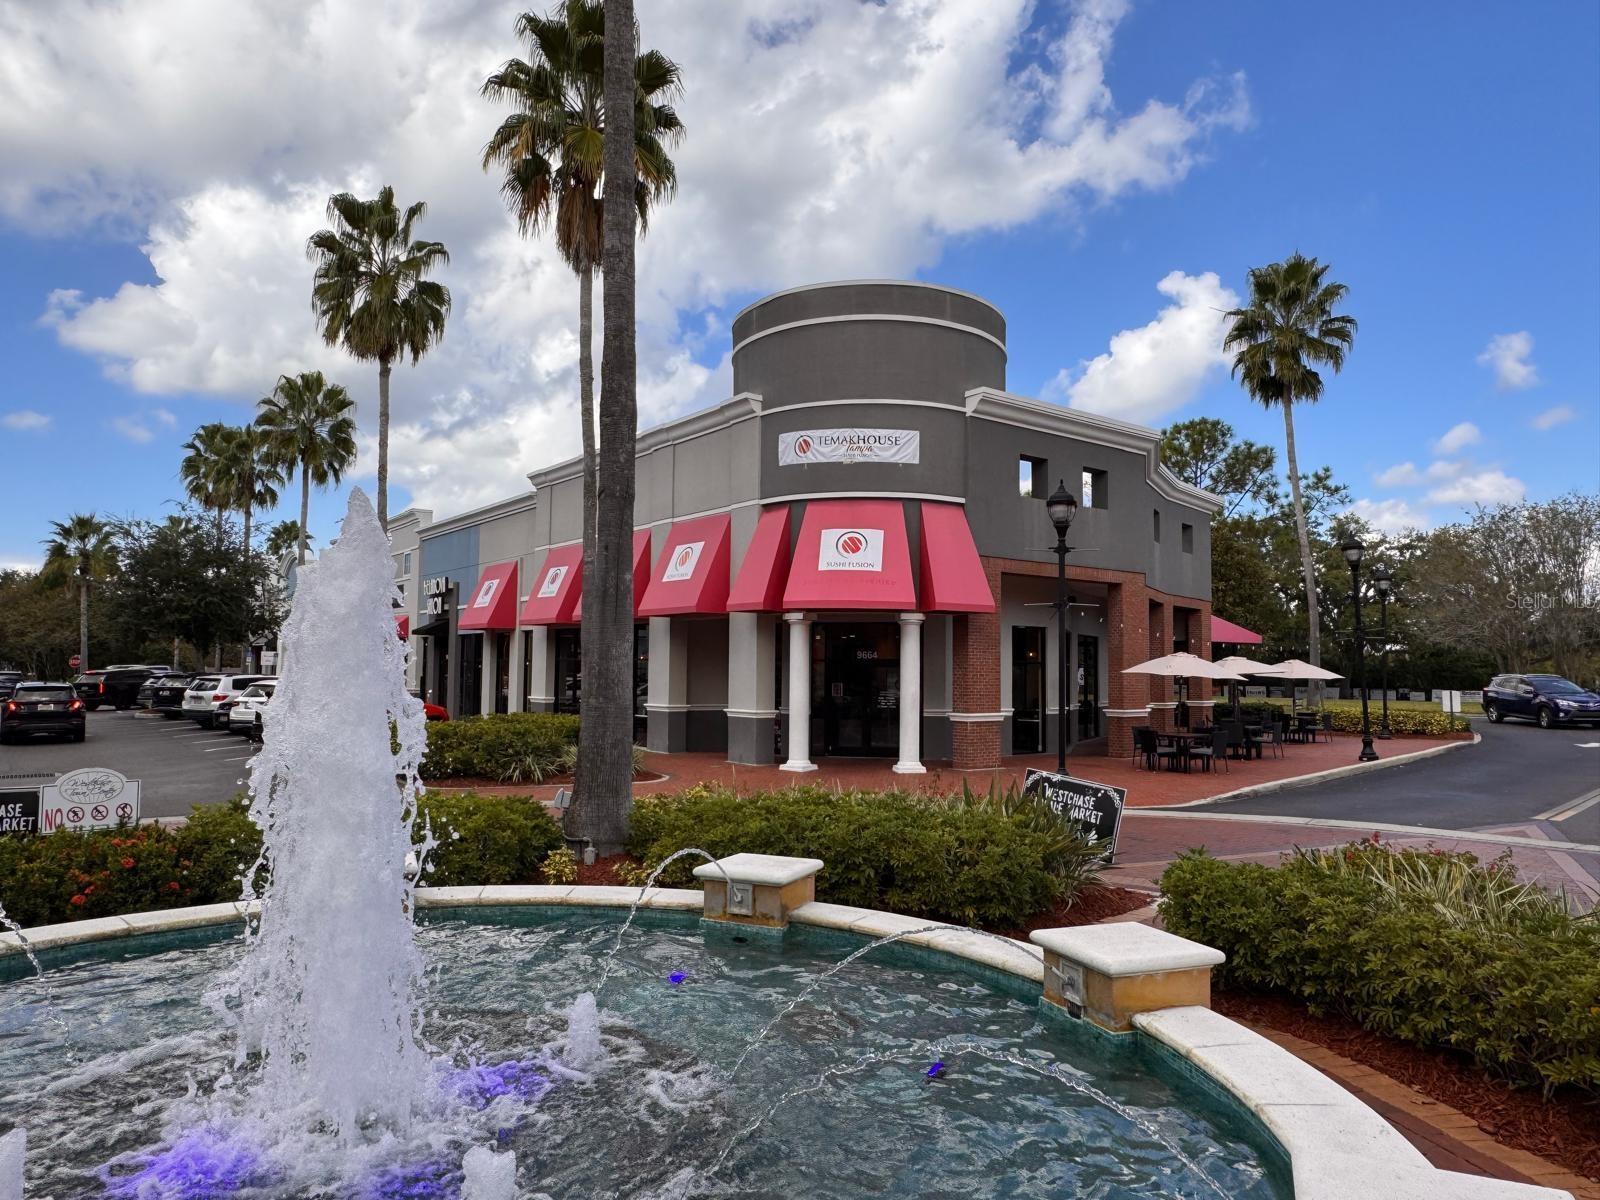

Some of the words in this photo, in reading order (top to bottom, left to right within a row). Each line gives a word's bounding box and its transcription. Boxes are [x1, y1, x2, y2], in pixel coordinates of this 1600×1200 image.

[818, 434, 901, 447] TEMAKHOUSE
[826, 561, 847, 569] SUSHI
[848, 561, 875, 569] FUSION
[856, 650, 878, 660] 9664
[0, 817, 36, 831] RKET
[44, 808, 64, 831] NO
